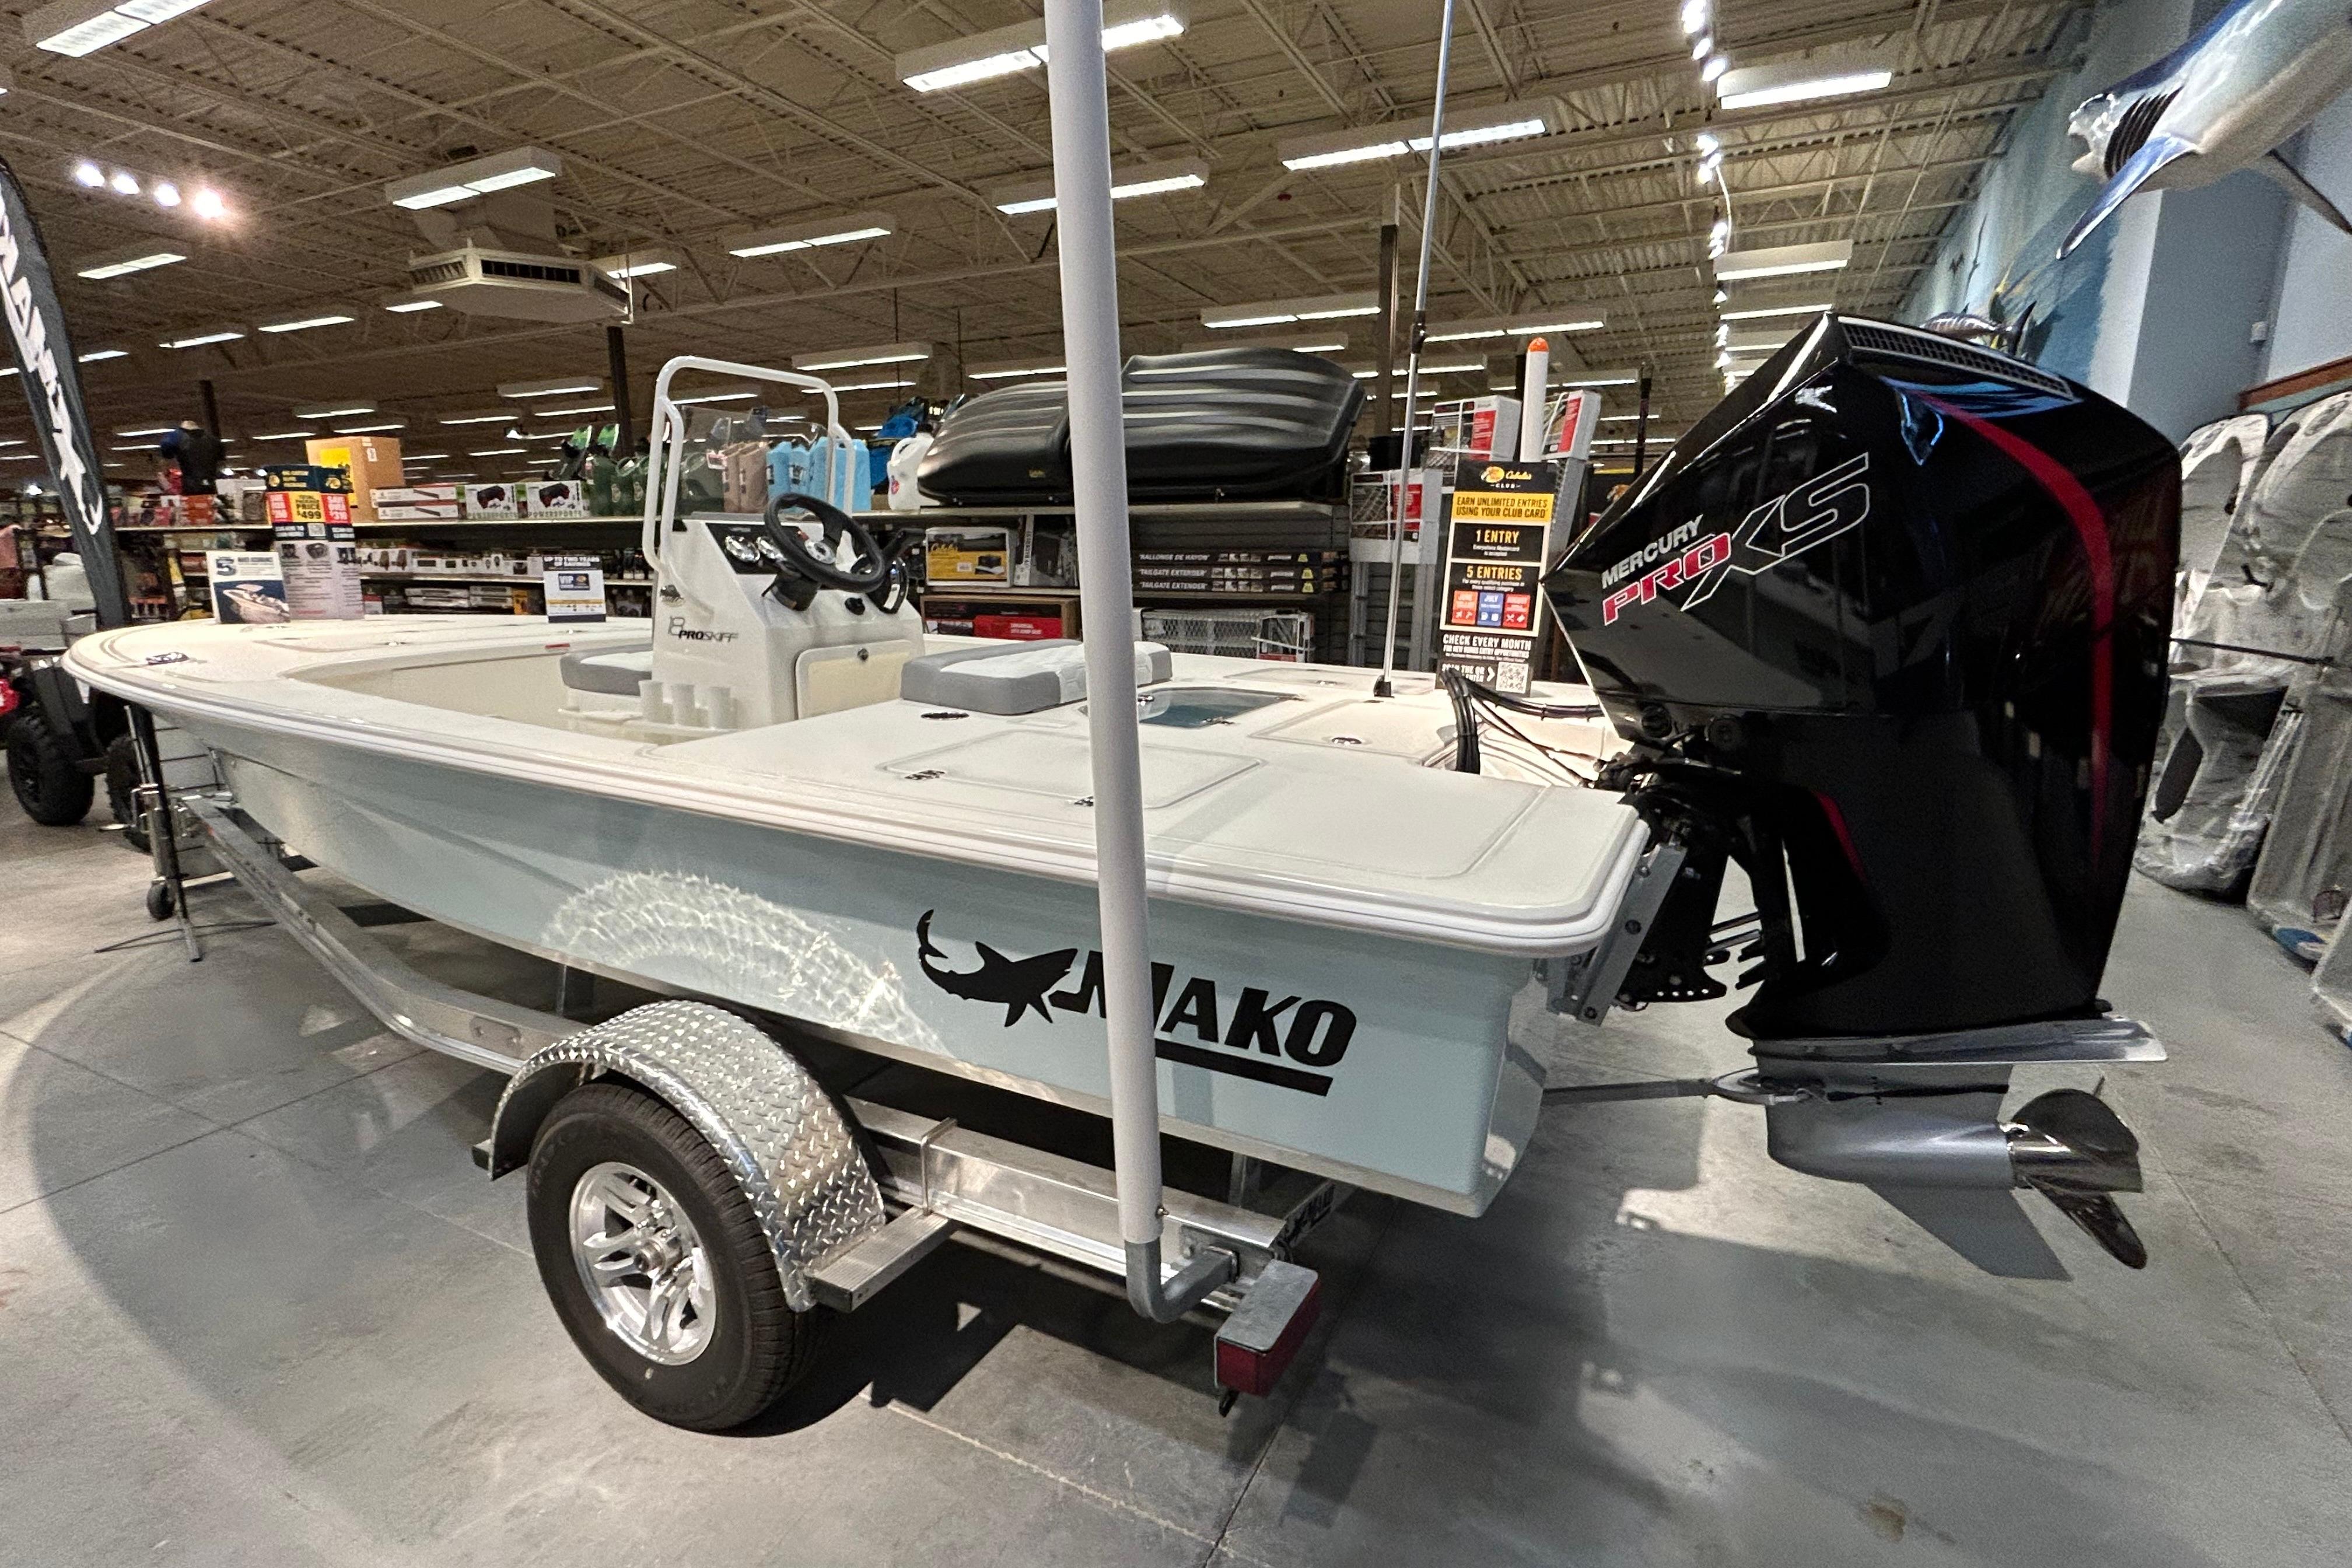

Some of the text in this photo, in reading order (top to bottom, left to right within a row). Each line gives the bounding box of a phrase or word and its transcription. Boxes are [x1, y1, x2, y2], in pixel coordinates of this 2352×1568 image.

[1457, 496, 1548, 508] EARN UNLIMITED ENTRIES
[1456, 506, 1546, 518] USING YOUR CLUB CARD
[1476, 529, 1520, 544] 1 ENTRY
[1601, 514, 1703, 589] MERCURY
[1466, 565, 1522, 581] 5 ENTRIES
[1602, 532, 1732, 626] PRO
[1443, 634, 1532, 651] CHECK EVERY MONTH
[1461, 664, 1474, 674] THE
[1049, 950, 1357, 1067] MAKO
